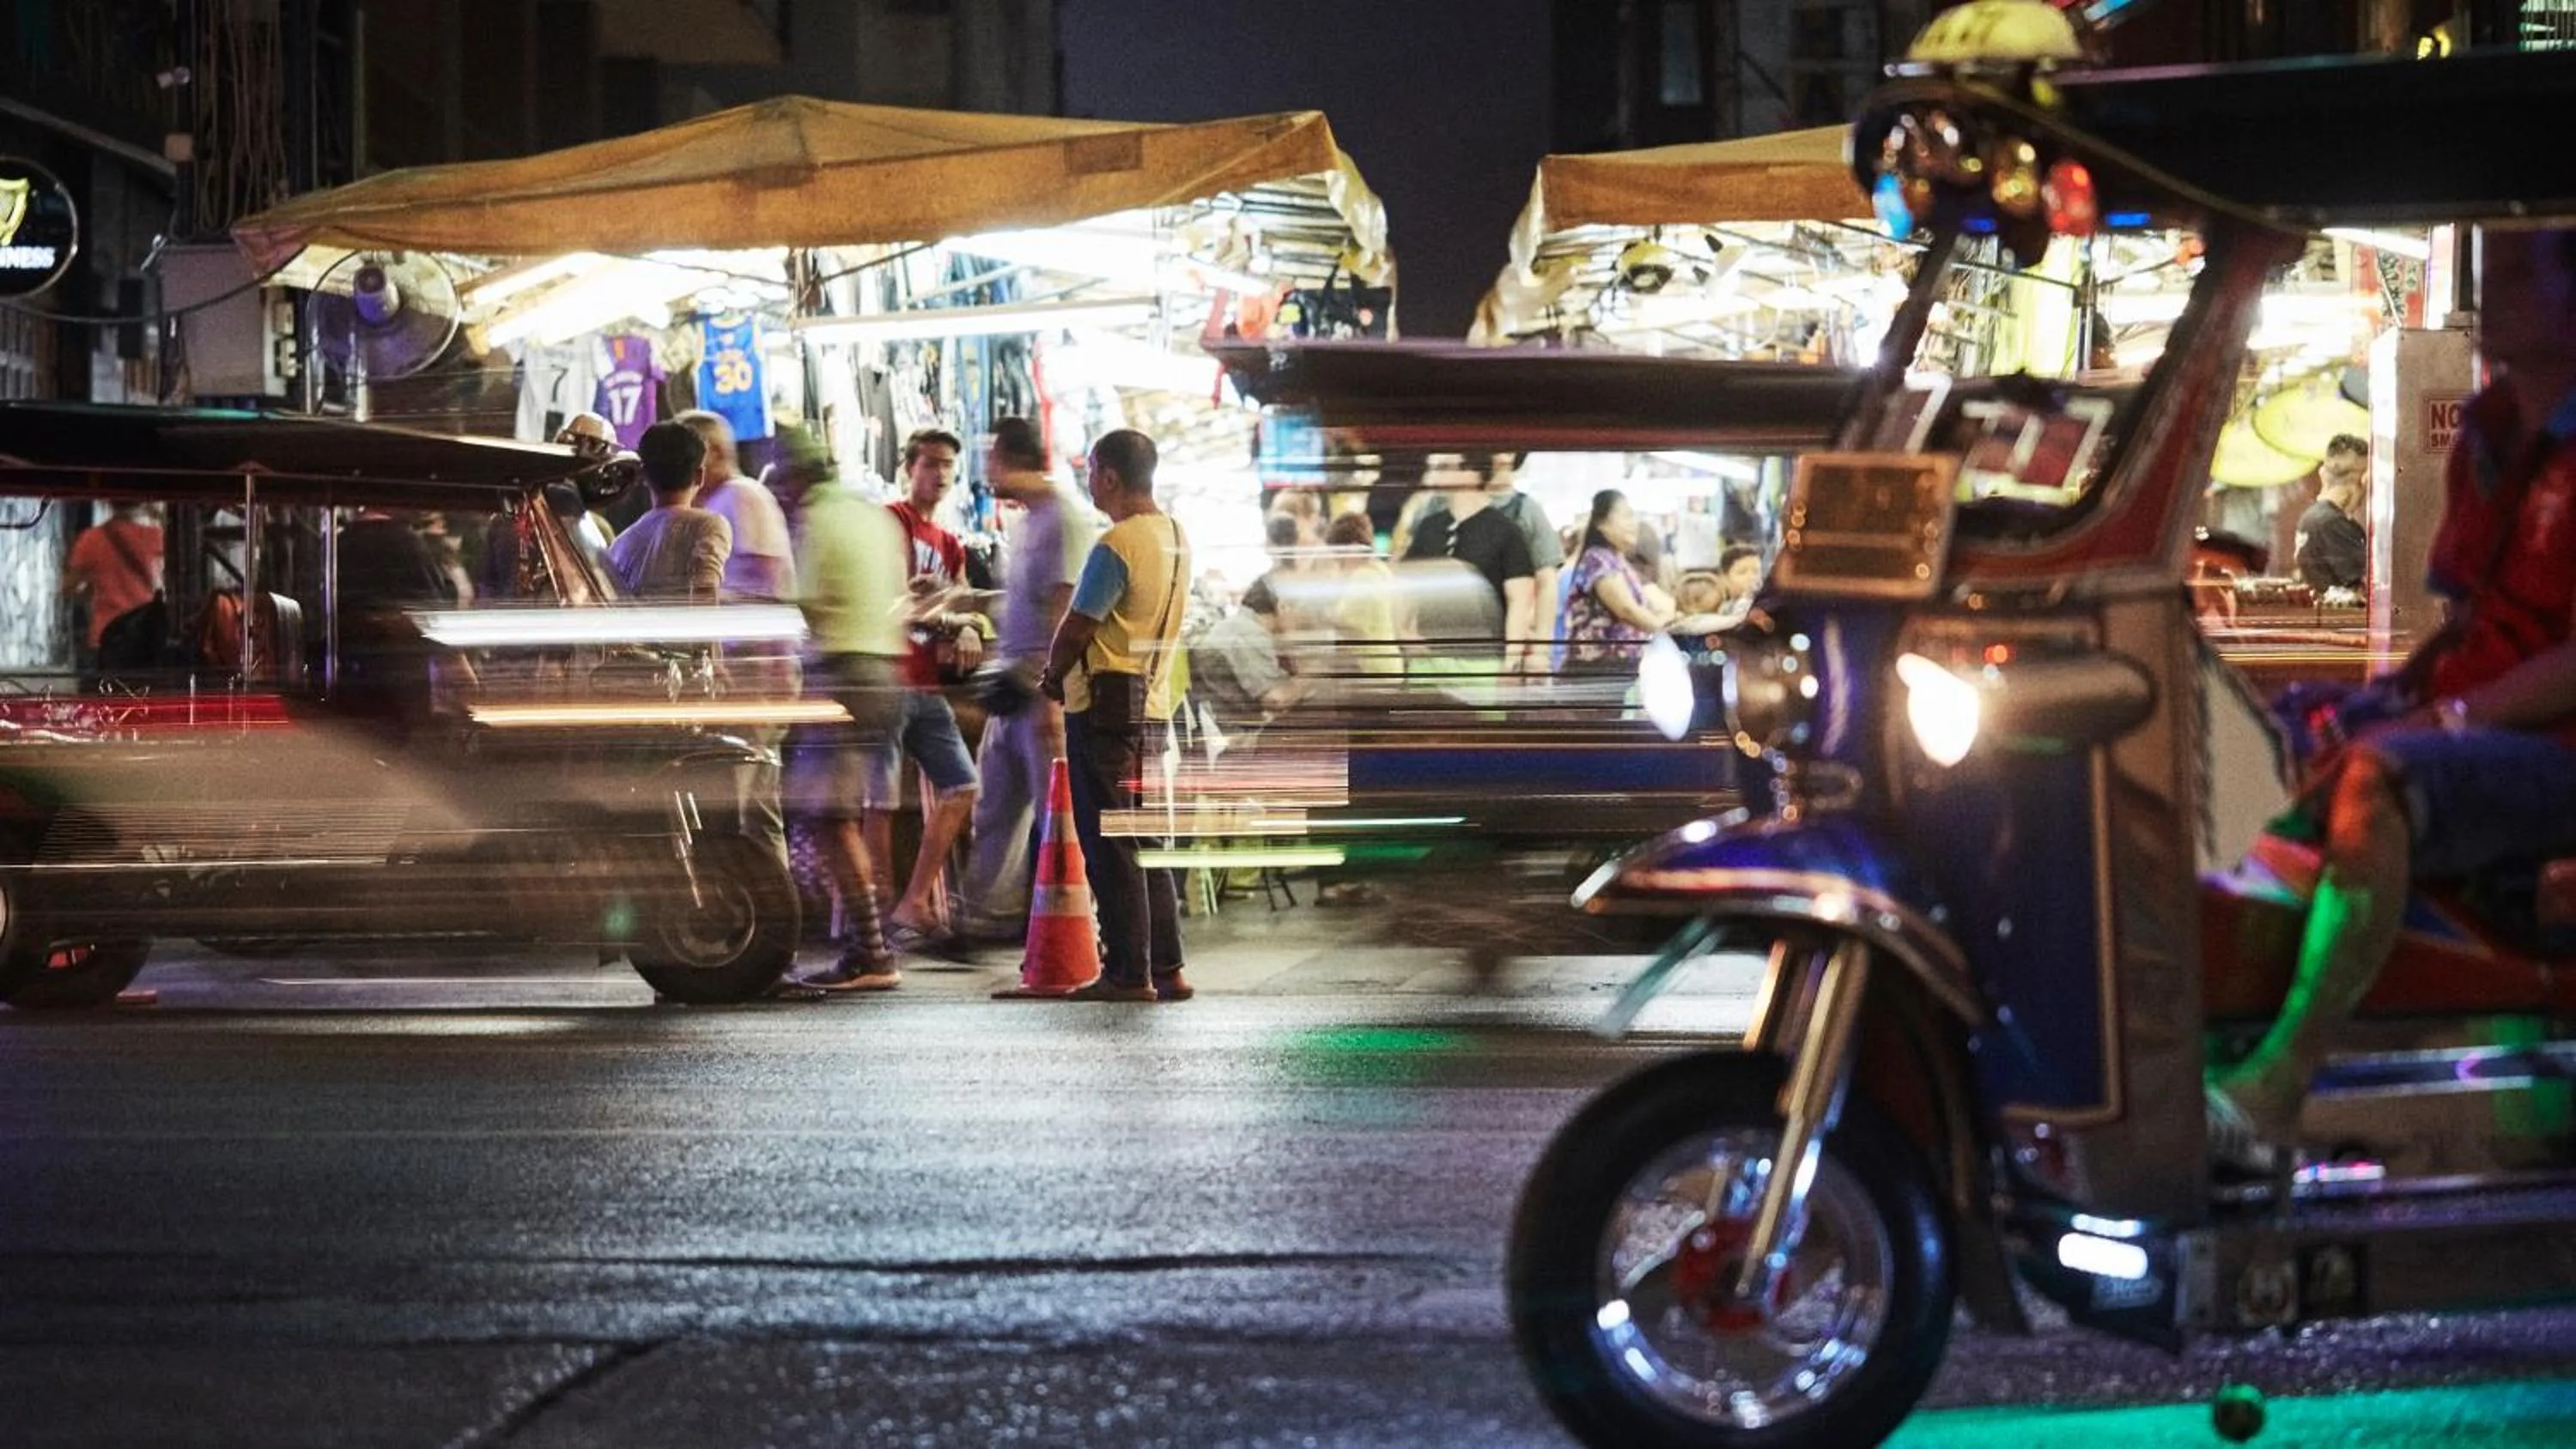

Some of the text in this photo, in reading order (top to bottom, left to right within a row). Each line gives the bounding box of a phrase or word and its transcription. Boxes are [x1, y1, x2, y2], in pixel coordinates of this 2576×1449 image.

[550, 363, 568, 403] 7
[714, 360, 753, 394] 30
[608, 385, 643, 427] 17
[2431, 403, 2463, 429] NO
